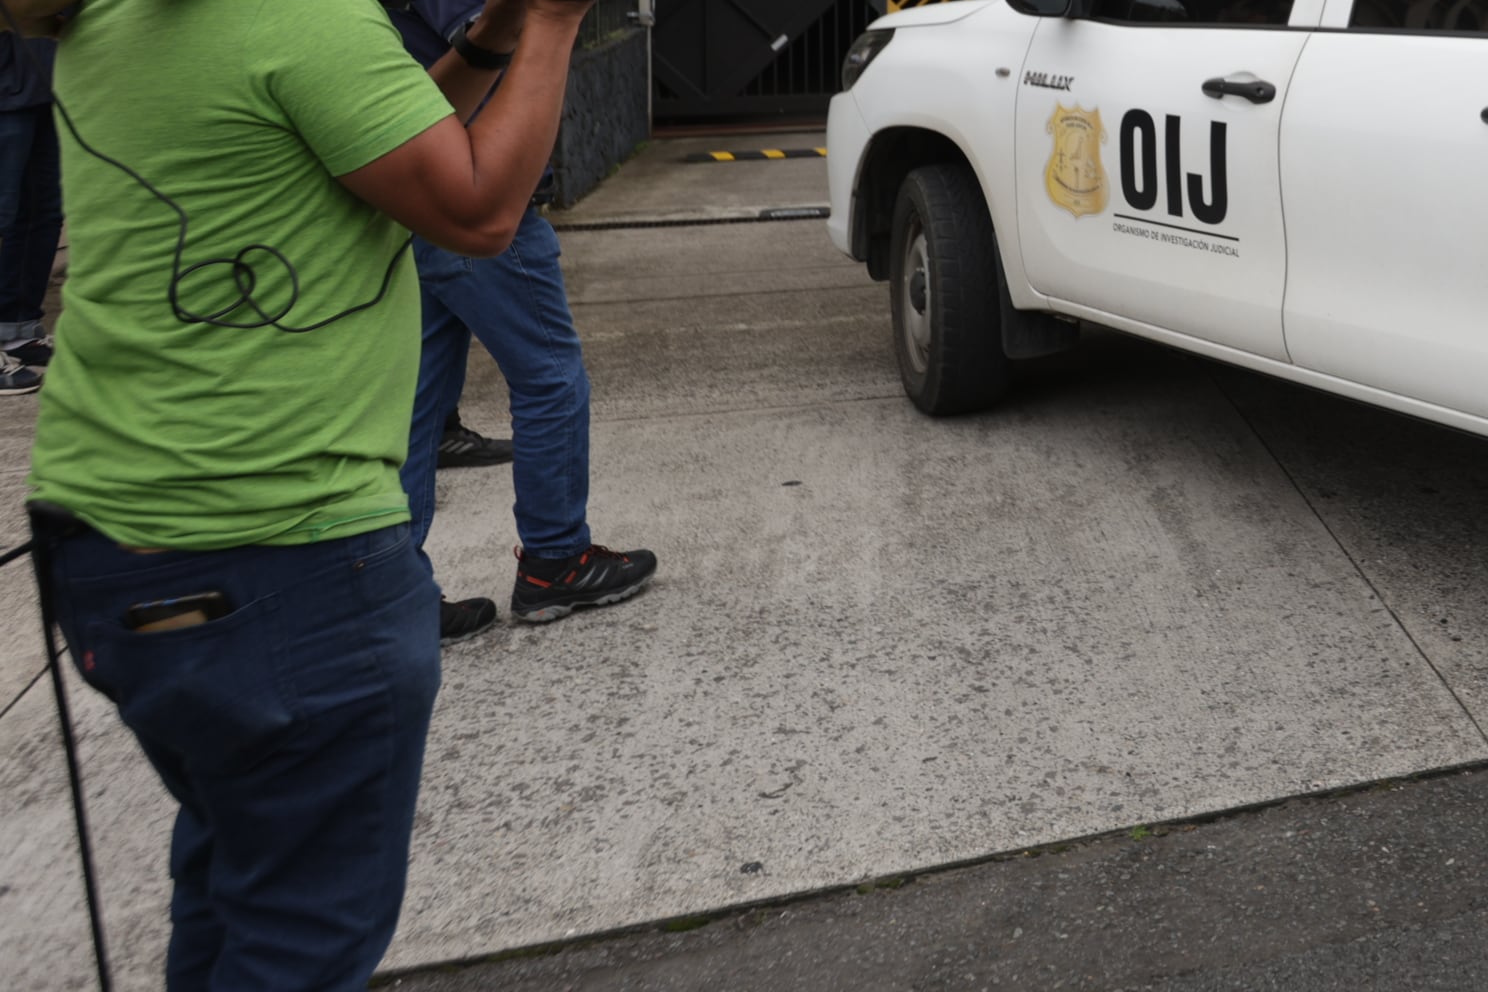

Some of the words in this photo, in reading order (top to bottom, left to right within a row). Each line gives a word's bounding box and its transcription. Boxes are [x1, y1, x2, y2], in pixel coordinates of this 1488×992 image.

[1024, 70, 1074, 91] HILUX
[1119, 108, 1228, 225] OIJ
[1113, 223, 1150, 239] ORGANISMO
[1151, 230, 1159, 240] DE
[1161, 233, 1209, 251] INVESTIGACIÓN
[1210, 244, 1239, 258] JUDICIAL
